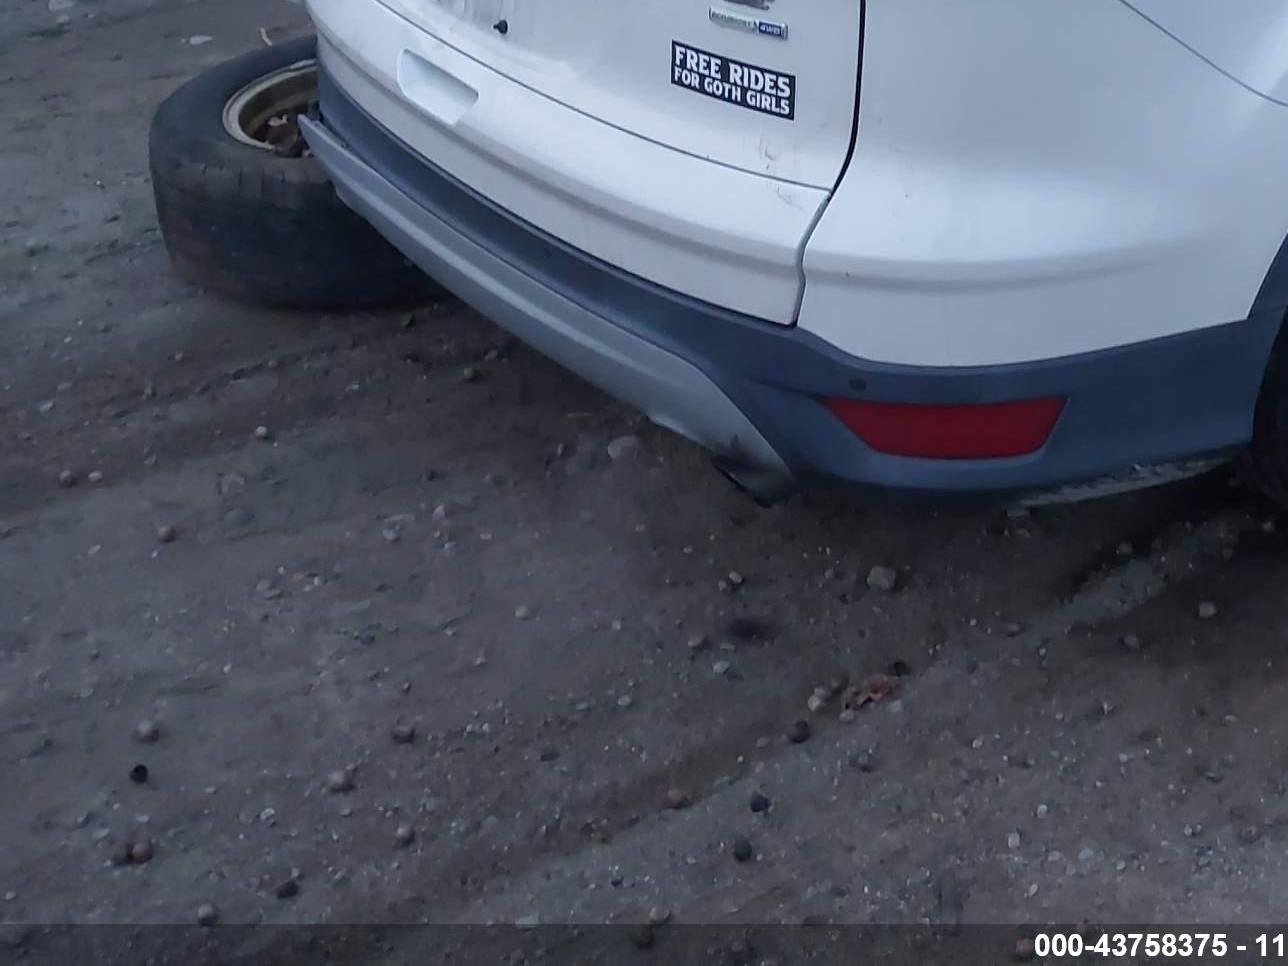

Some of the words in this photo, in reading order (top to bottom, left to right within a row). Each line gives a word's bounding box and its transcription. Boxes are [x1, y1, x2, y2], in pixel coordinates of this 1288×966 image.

[760, 24, 780, 35] 4WD
[674, 44, 722, 80] FREE
[728, 62, 791, 98] RIDES
[674, 66, 700, 89] FOR
[704, 77, 741, 102] GOTH
[746, 89, 790, 115] GIRLS
